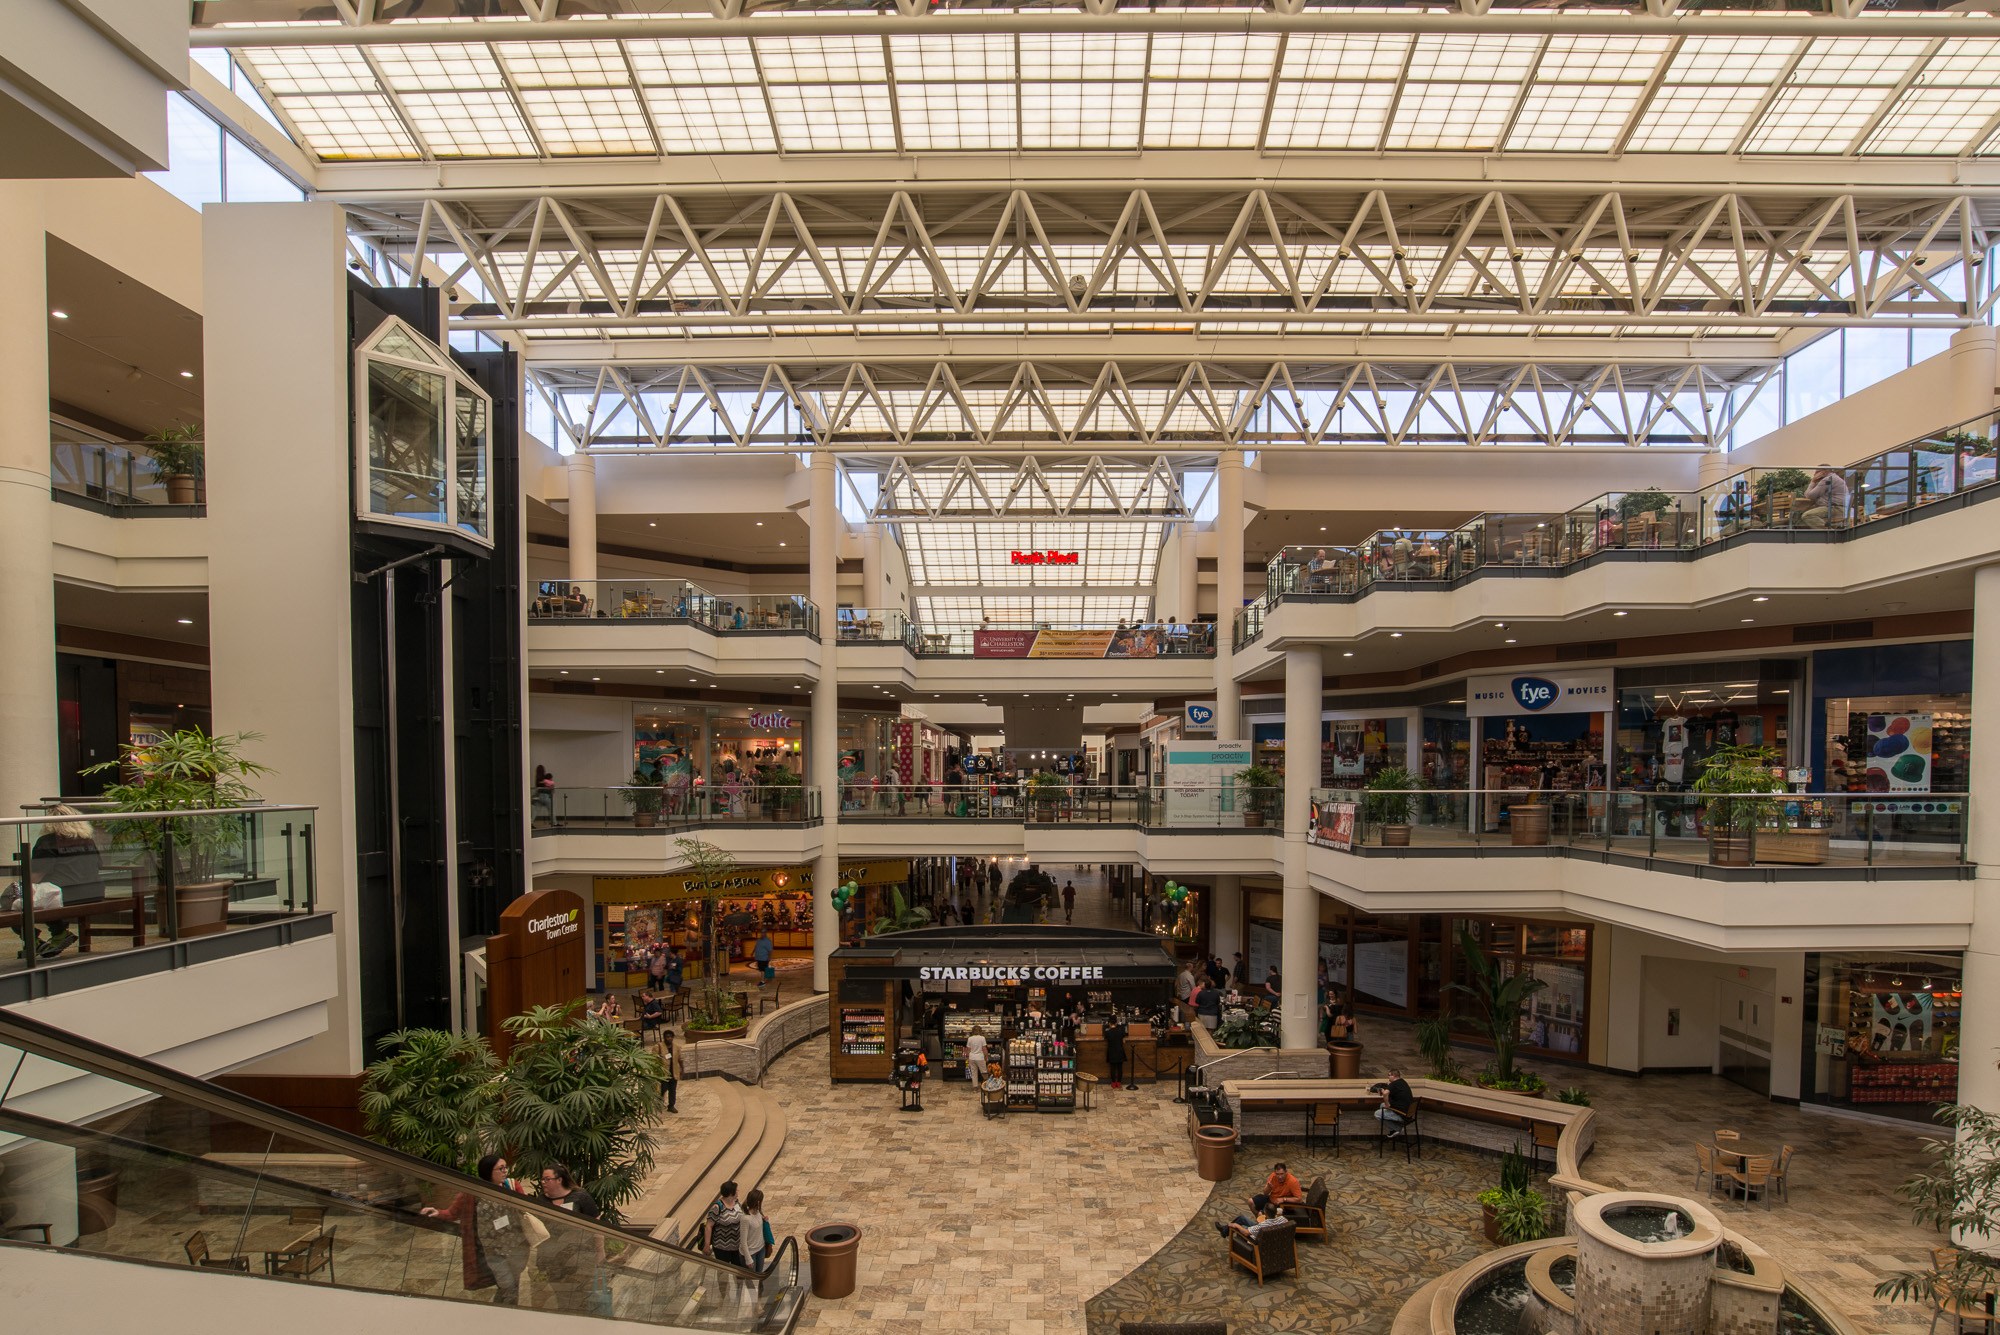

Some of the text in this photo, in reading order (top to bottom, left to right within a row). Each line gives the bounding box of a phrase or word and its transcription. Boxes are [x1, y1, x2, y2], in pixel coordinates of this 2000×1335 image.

[1474, 692, 1505, 700] MUSIC
[1567, 685, 1607, 695] MOVIES
[749, 711, 792, 729] Justice
[1212, 752, 1244, 761] proactiv
[528, 912, 569, 934] Charleston
[546, 923, 578, 940] Town Center
[919, 966, 1103, 980] STARBUCKS COFFEE
[1830, 1043, 1843, 1056] 15
